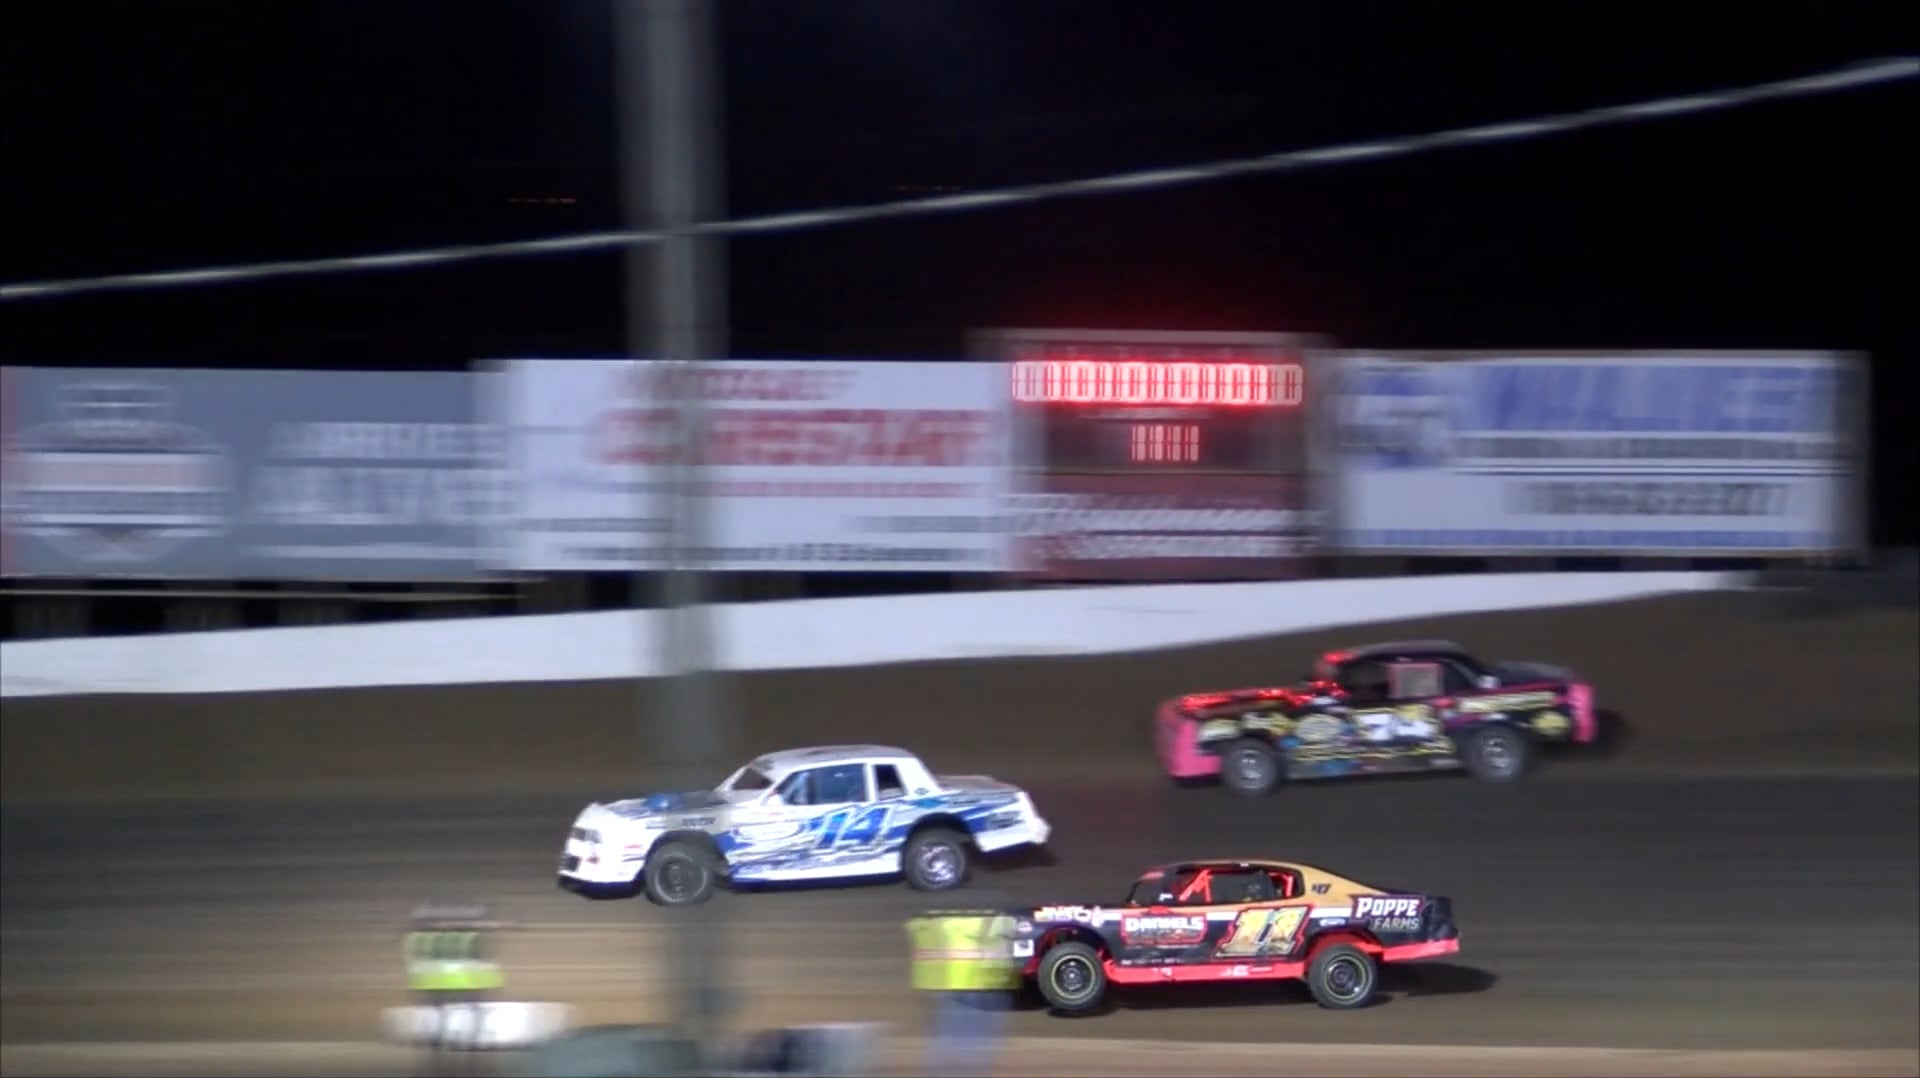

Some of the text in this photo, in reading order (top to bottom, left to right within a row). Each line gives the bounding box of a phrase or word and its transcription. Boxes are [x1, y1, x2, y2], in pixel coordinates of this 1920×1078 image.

[812, 807, 888, 850] 14
[1356, 897, 1419, 918] POPPE
[1125, 916, 1204, 932] DANIELS
[1373, 917, 1420, 930] FARMS
